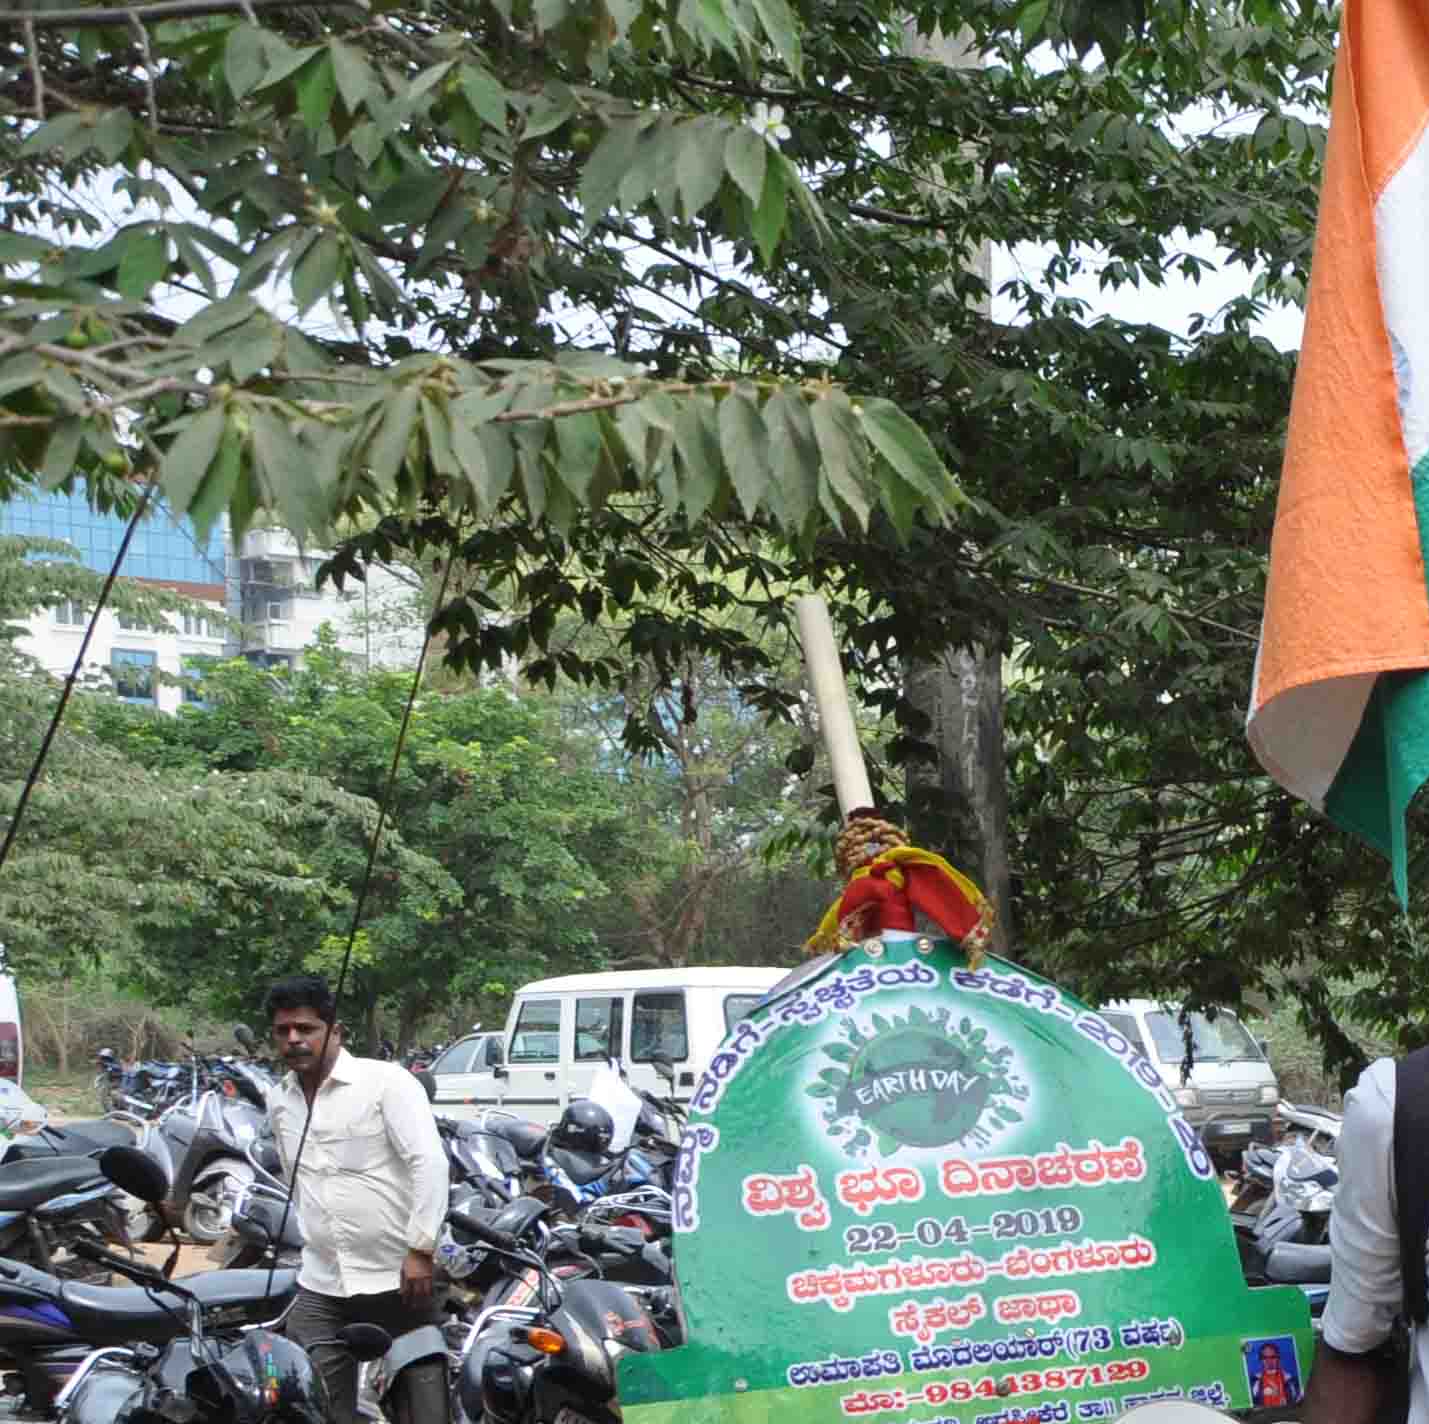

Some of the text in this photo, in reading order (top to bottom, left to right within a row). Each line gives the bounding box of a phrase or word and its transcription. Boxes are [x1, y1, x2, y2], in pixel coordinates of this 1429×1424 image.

[855, 1069, 979, 1105] EARTH DAY
[745, 1139, 1143, 1227] ವಿಶ್ವ ಭೂ ದಿನಾಚರಣೆ
[847, 1206, 1081, 1254] 22-04-2019
[892, 1292, 1077, 1340] ಸೈಕಲ್ ಜಾಥಾ
[790, 1351, 900, 1385] ಉಮಾಪತಿ
